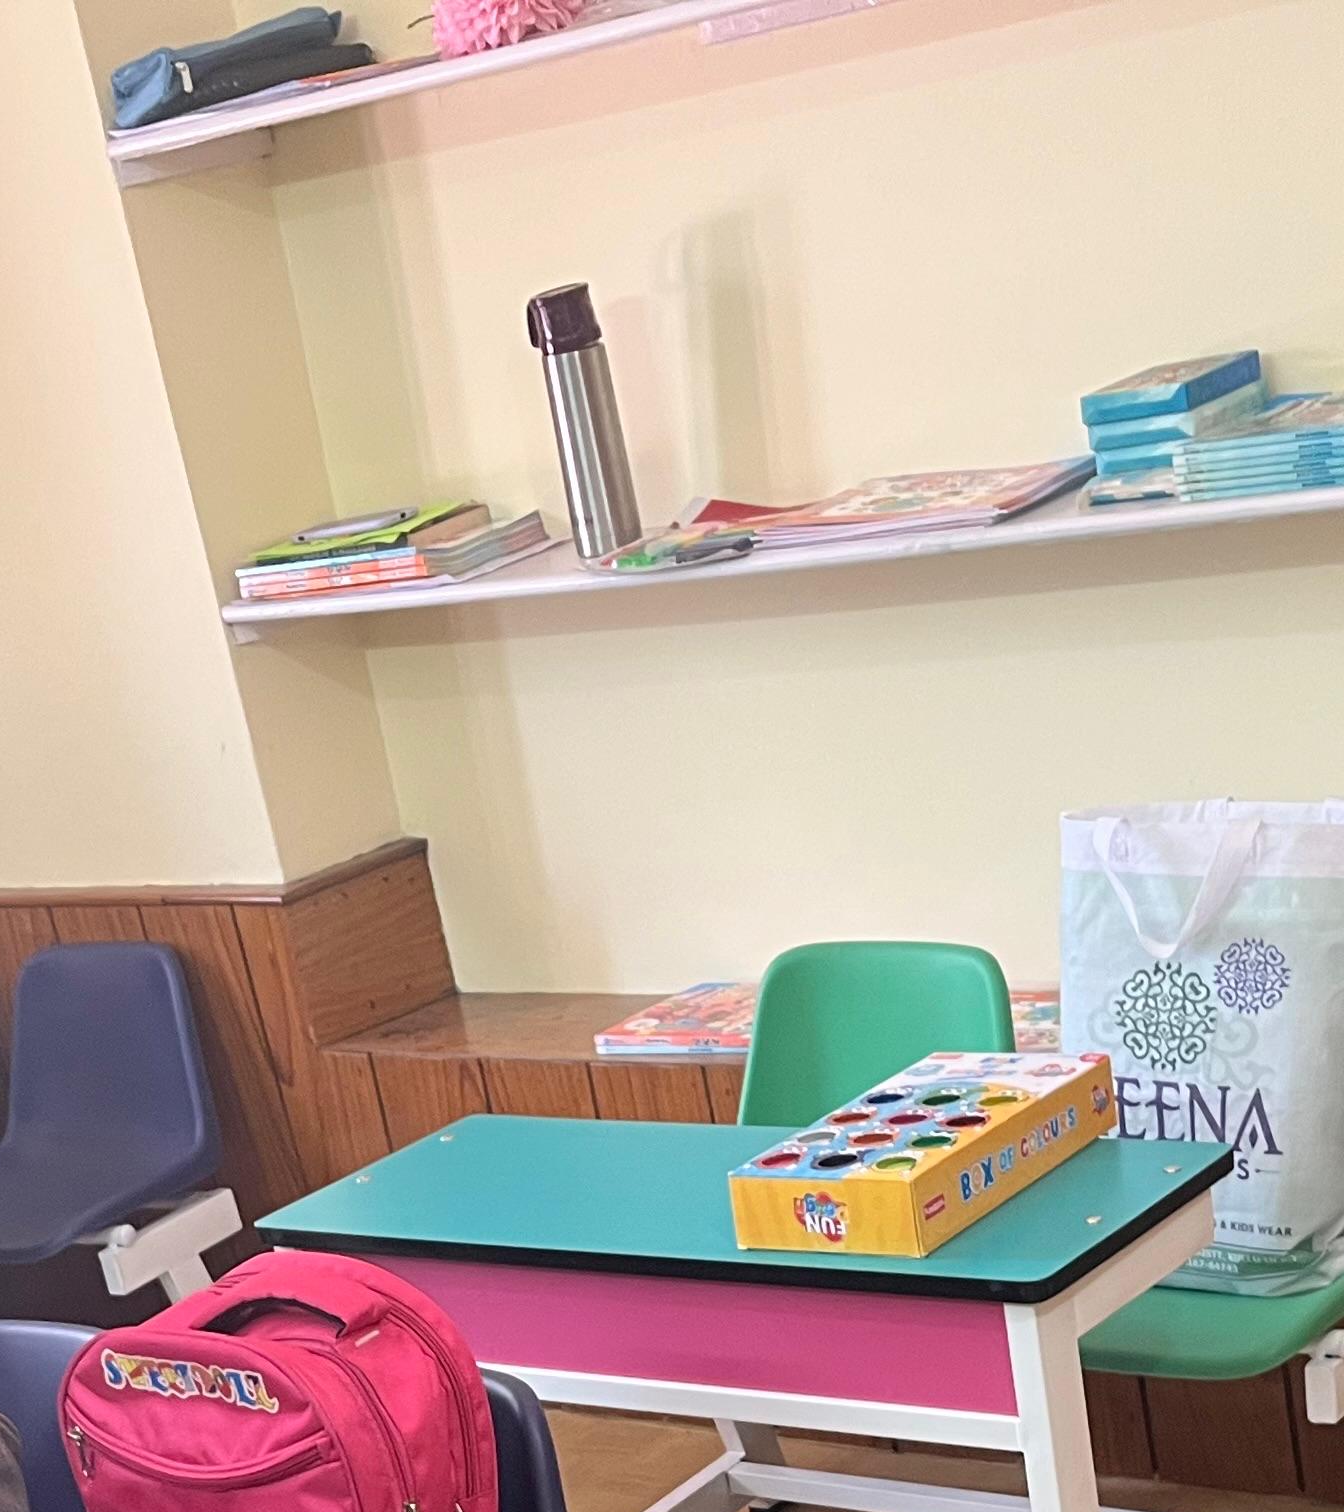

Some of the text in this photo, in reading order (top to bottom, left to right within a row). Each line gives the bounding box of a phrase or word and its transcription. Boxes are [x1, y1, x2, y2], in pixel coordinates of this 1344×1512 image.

[1113, 1076, 1284, 1155] EENA
[960, 1105, 1077, 1204] BOX OF COLOURS
[804, 1211, 847, 1235] FUN
[1229, 1220, 1255, 1233] KIDS
[1257, 1223, 1292, 1237] WEAR
